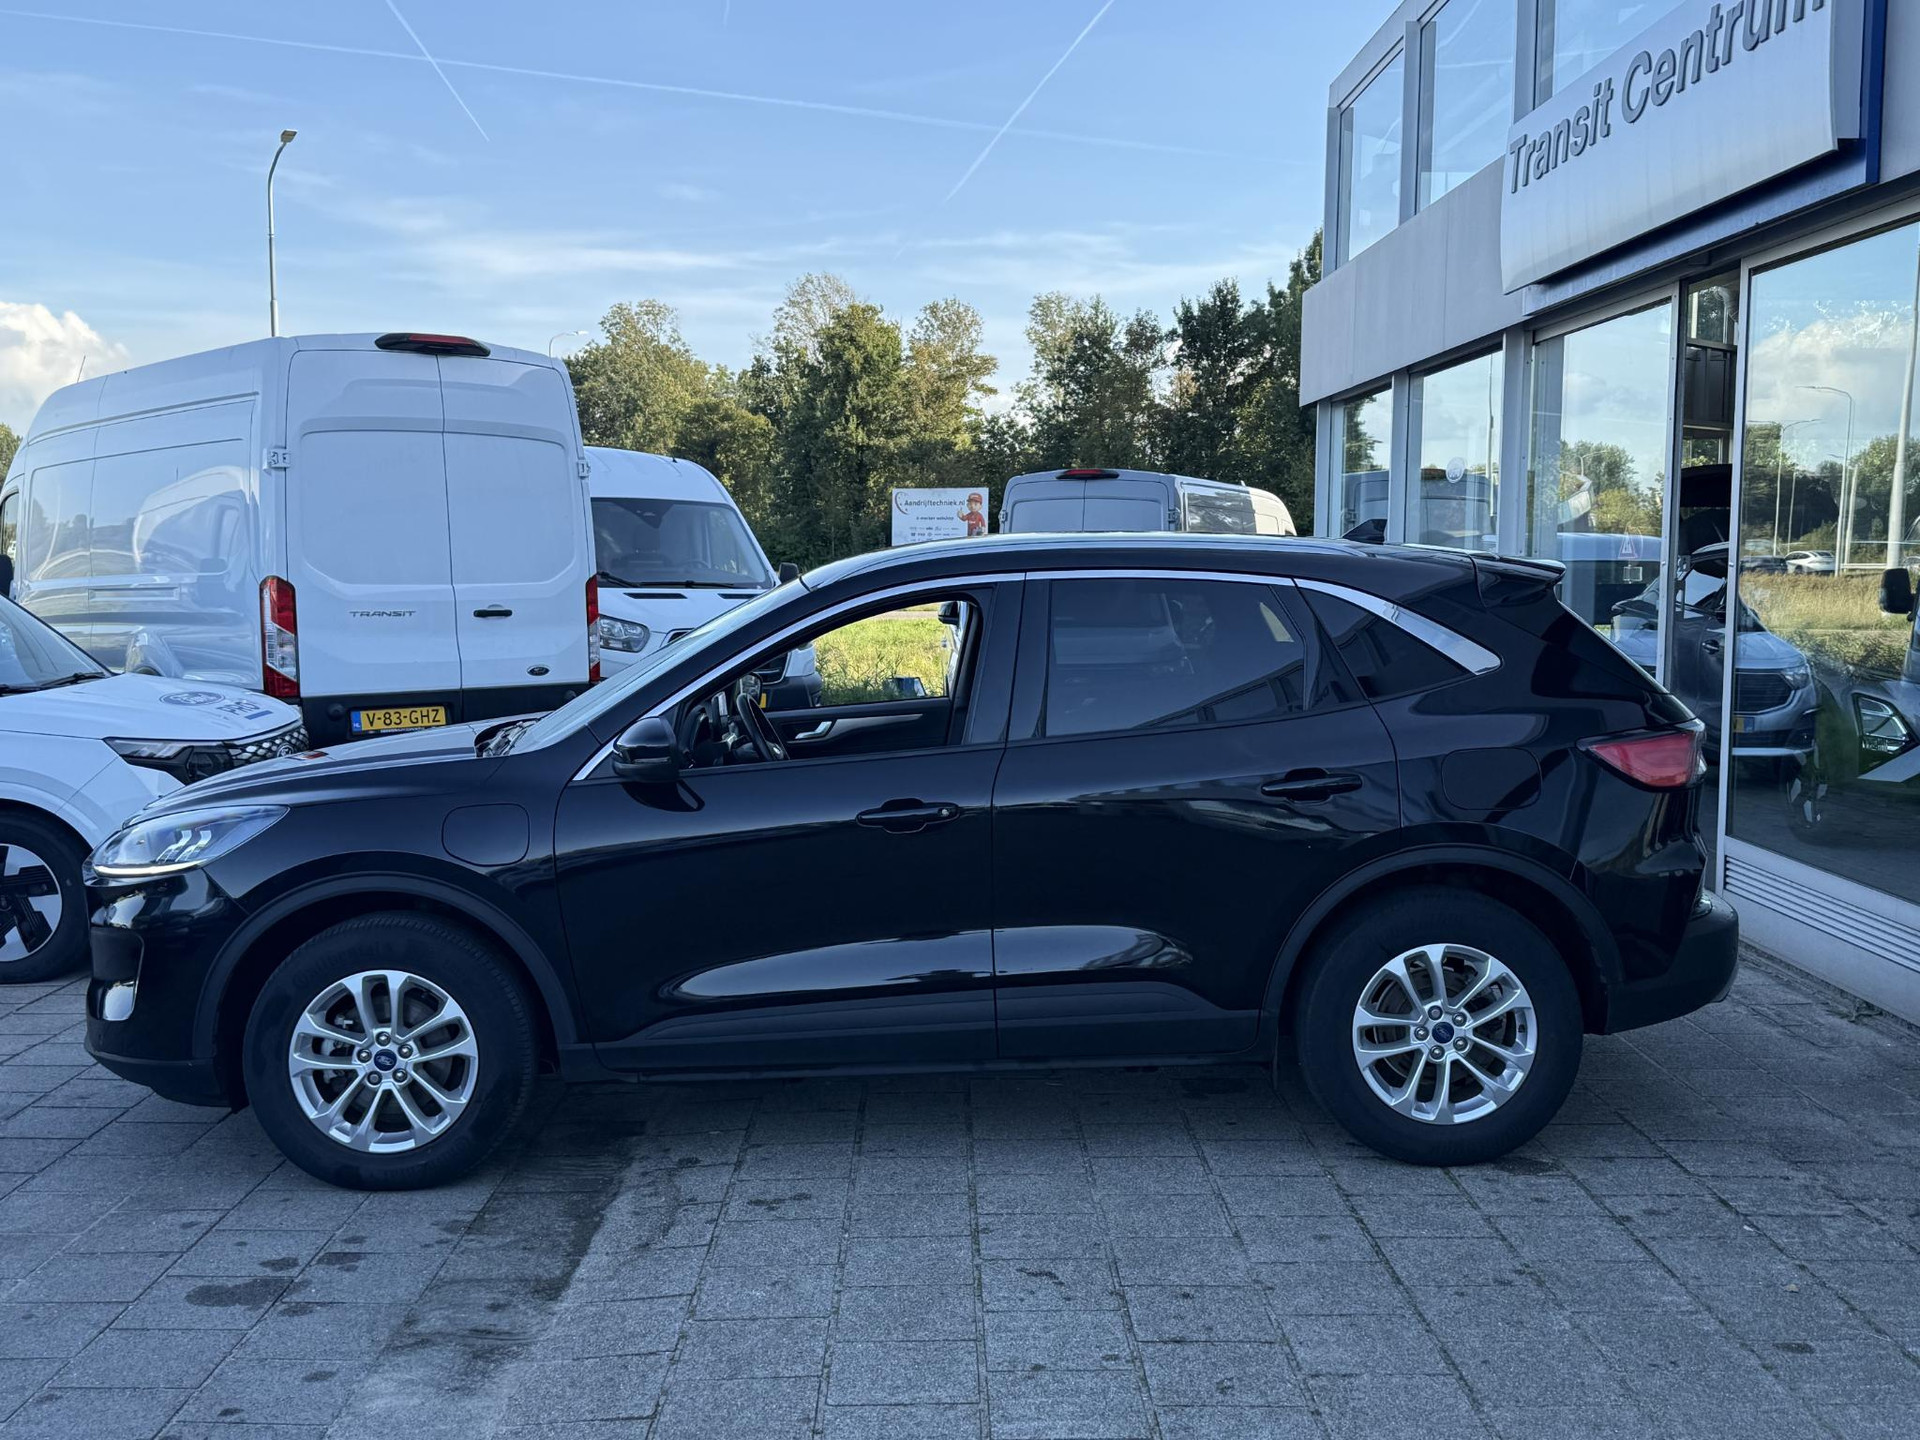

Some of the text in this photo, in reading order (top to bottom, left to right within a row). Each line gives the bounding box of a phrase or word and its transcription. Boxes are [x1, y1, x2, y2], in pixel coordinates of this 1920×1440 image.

[1509, 77, 1614, 194] Transit
[349, 610, 416, 618] TRANSIT
[366, 708, 441, 728] V-83-GHZ
